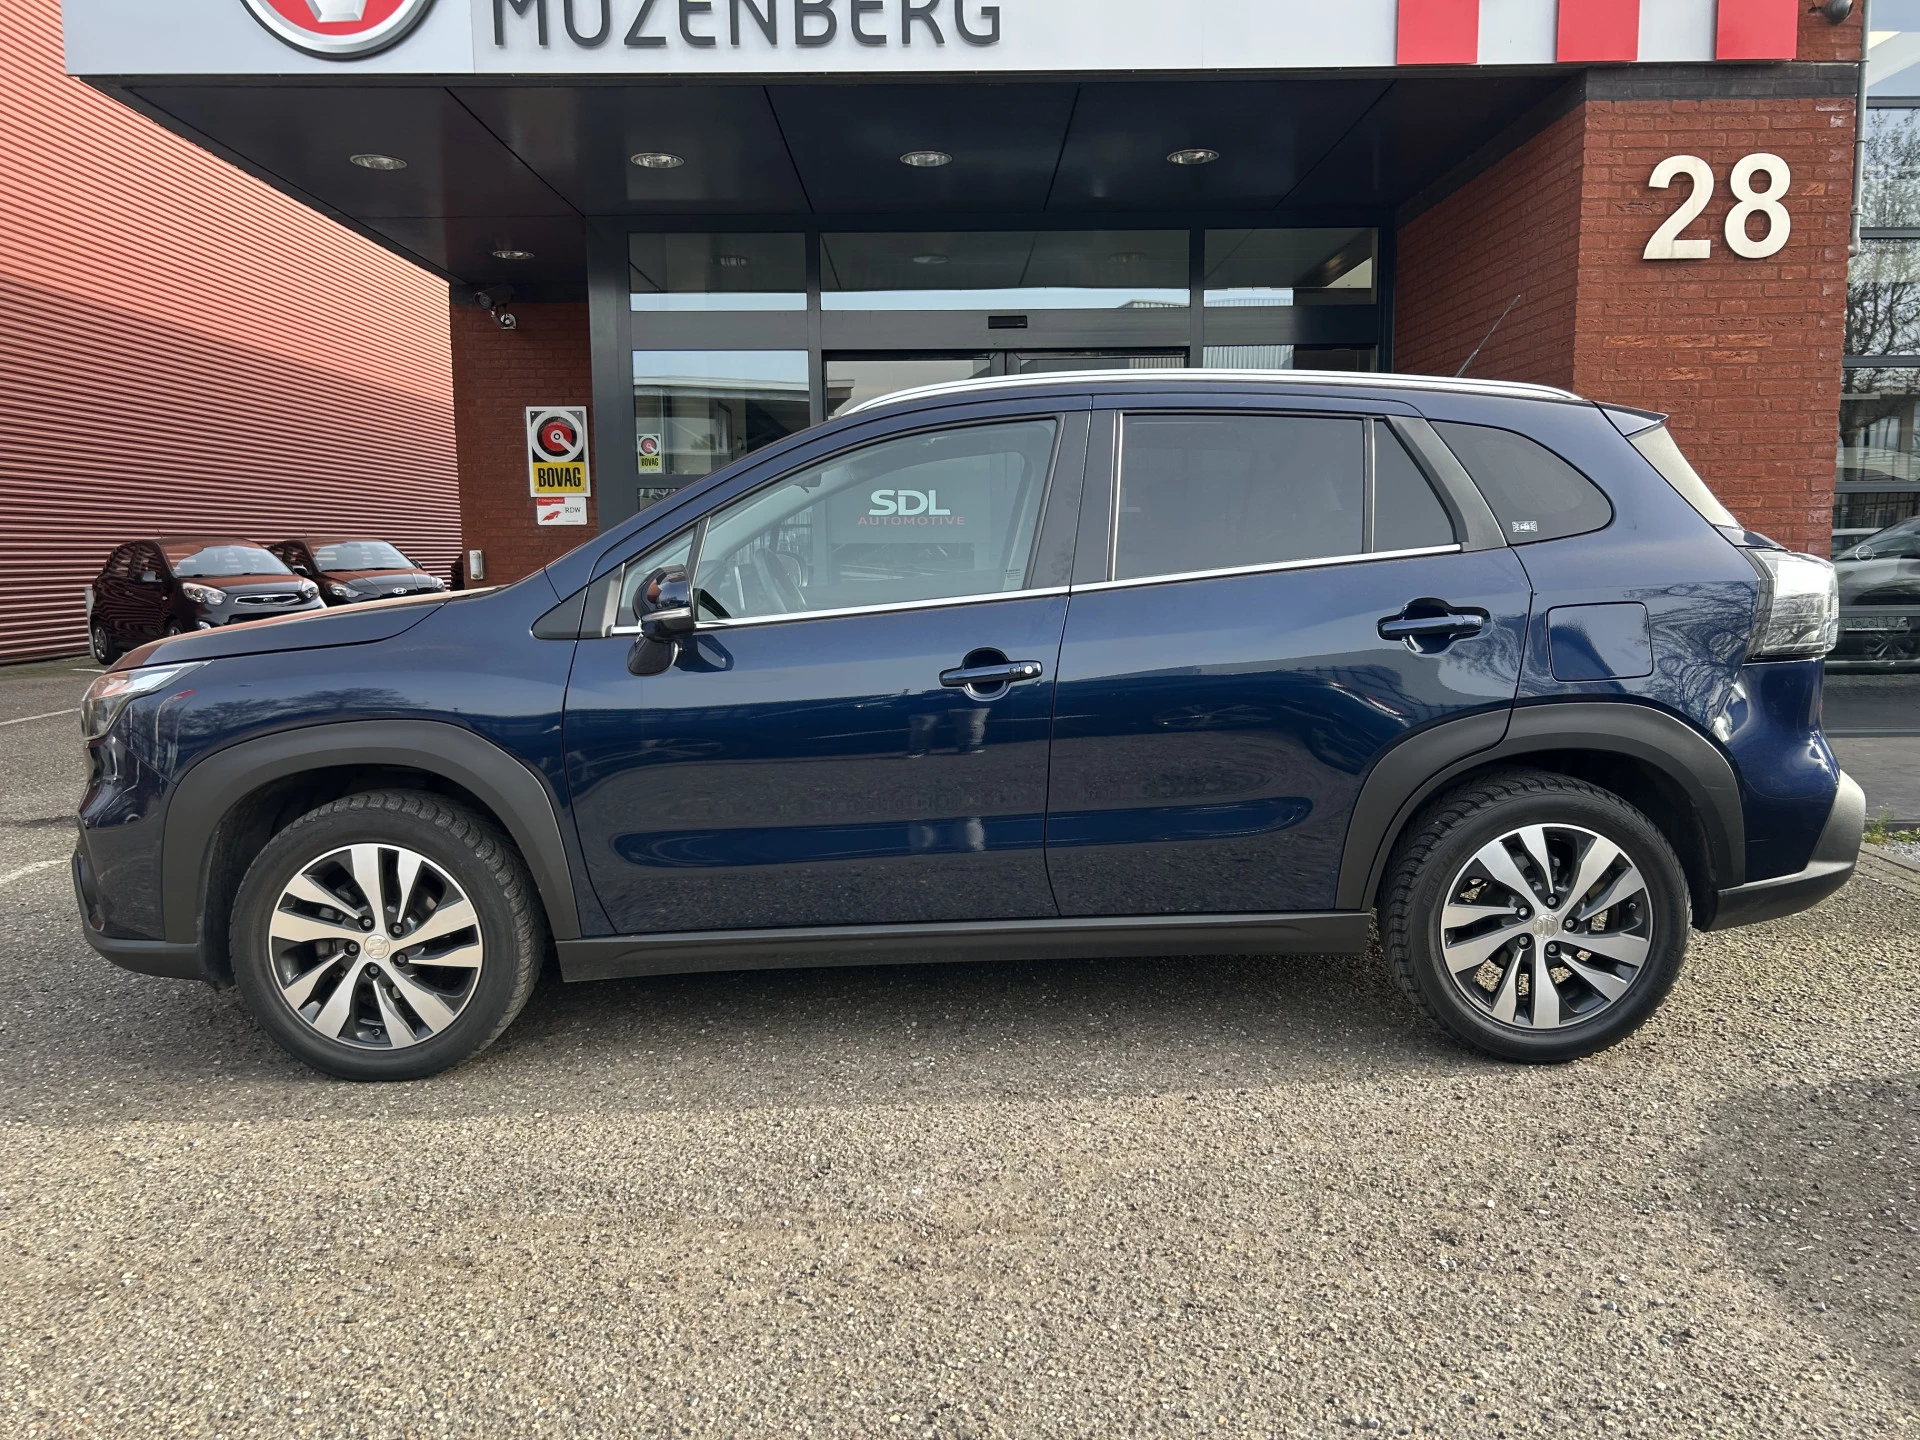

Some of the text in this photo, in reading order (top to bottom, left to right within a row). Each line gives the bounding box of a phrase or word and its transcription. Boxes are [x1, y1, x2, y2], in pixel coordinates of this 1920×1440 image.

[1643, 152, 1791, 260] 28
[641, 458, 659, 467] BOVAG
[538, 467, 582, 488] BOVAG
[869, 489, 951, 516] SDL
[858, 516, 966, 526] AUTOMOTIVE
